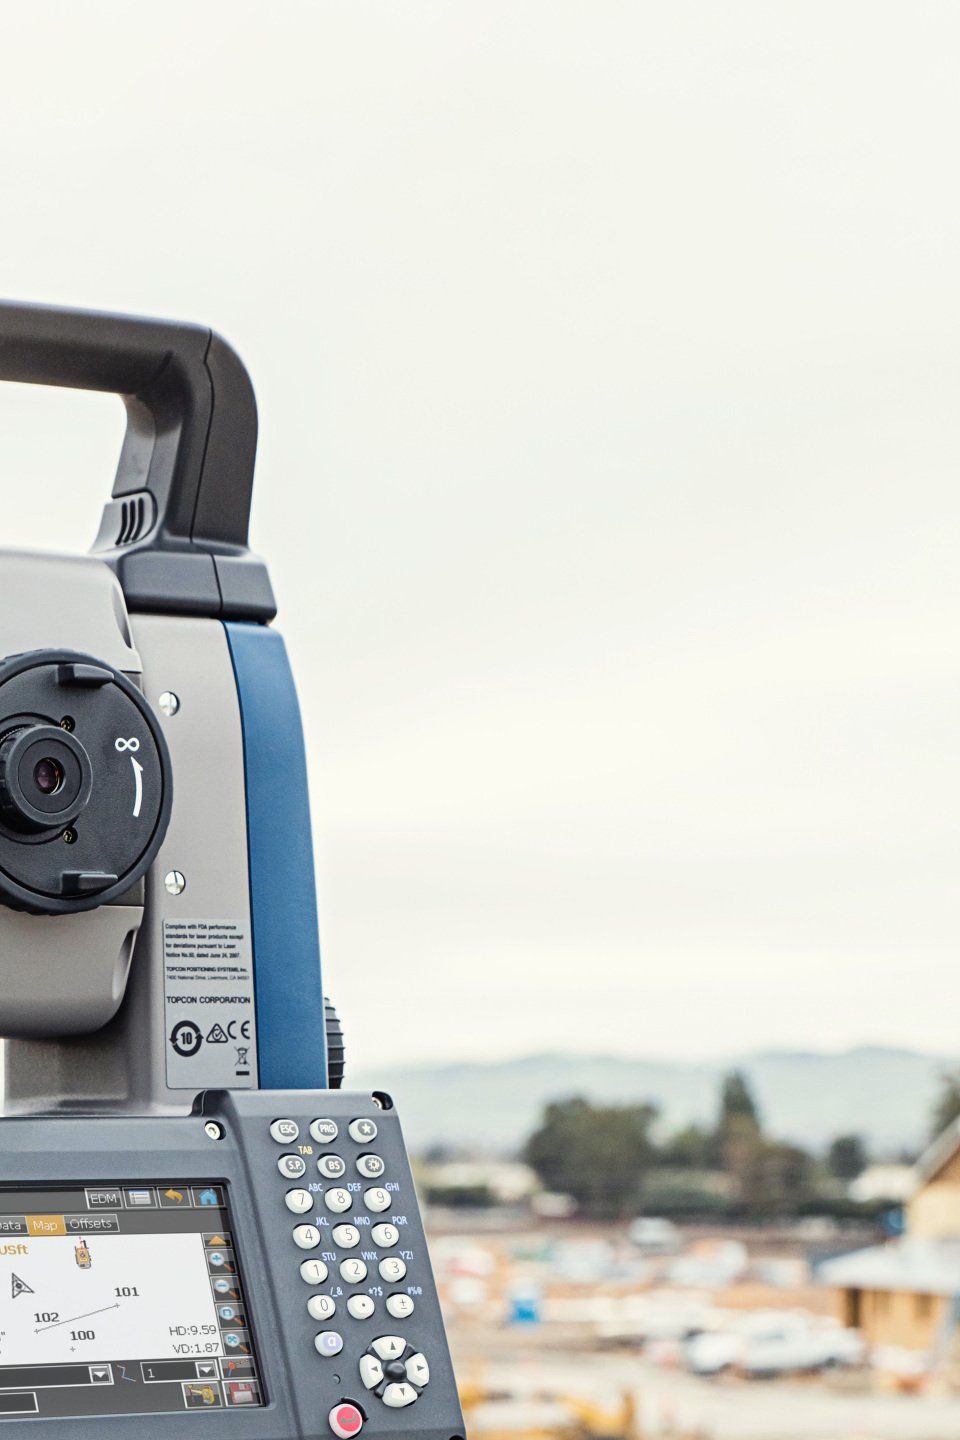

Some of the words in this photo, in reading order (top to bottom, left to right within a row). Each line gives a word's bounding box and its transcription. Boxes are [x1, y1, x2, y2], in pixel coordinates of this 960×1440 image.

[199, 996, 251, 1004] CORPORATION
[181, 1032, 193, 1045] 10
[280, 1124, 295, 1134] ESC
[319, 1124, 335, 1134] PRG
[298, 1145, 313, 1155] TAB
[288, 1161, 302, 1170] S.P.
[328, 1161, 341, 1170] BS
[308, 1183, 324, 1192] ABC
[347, 1183, 362, 1192] DEF
[385, 1182, 400, 1192] GHI
[90, 1193, 118, 1204] EDM
[297, 1192, 305, 1206] 7
[336, 1191, 346, 1204] 8
[376, 1190, 385, 1204] 9
[69, 1218, 112, 1230] Offsets
[315, 1217, 330, 1226] JKL
[354, 1216, 371, 1226] MNO
[392, 1216, 408, 1225] PQR
[32, 1220, 58, 1233] Map
[305, 1228, 313, 1242] 4
[345, 1227, 353, 1241] 5
[384, 1227, 393, 1240] 6
[322, 1252, 337, 1261] STU
[361, 1252, 378, 1260] VWX
[352, 1262, 361, 1275] 2
[391, 1261, 400, 1274] 3
[114, 1286, 140, 1298] 101
[320, 1298, 329, 1312] 0
[33, 1311, 60, 1323] 102
[70, 1330, 96, 1341] 100
[169, 1324, 217, 1336] HD:9.59
[172, 1342, 220, 1354] VD:1.87
[147, 1368, 155, 1379] 1
